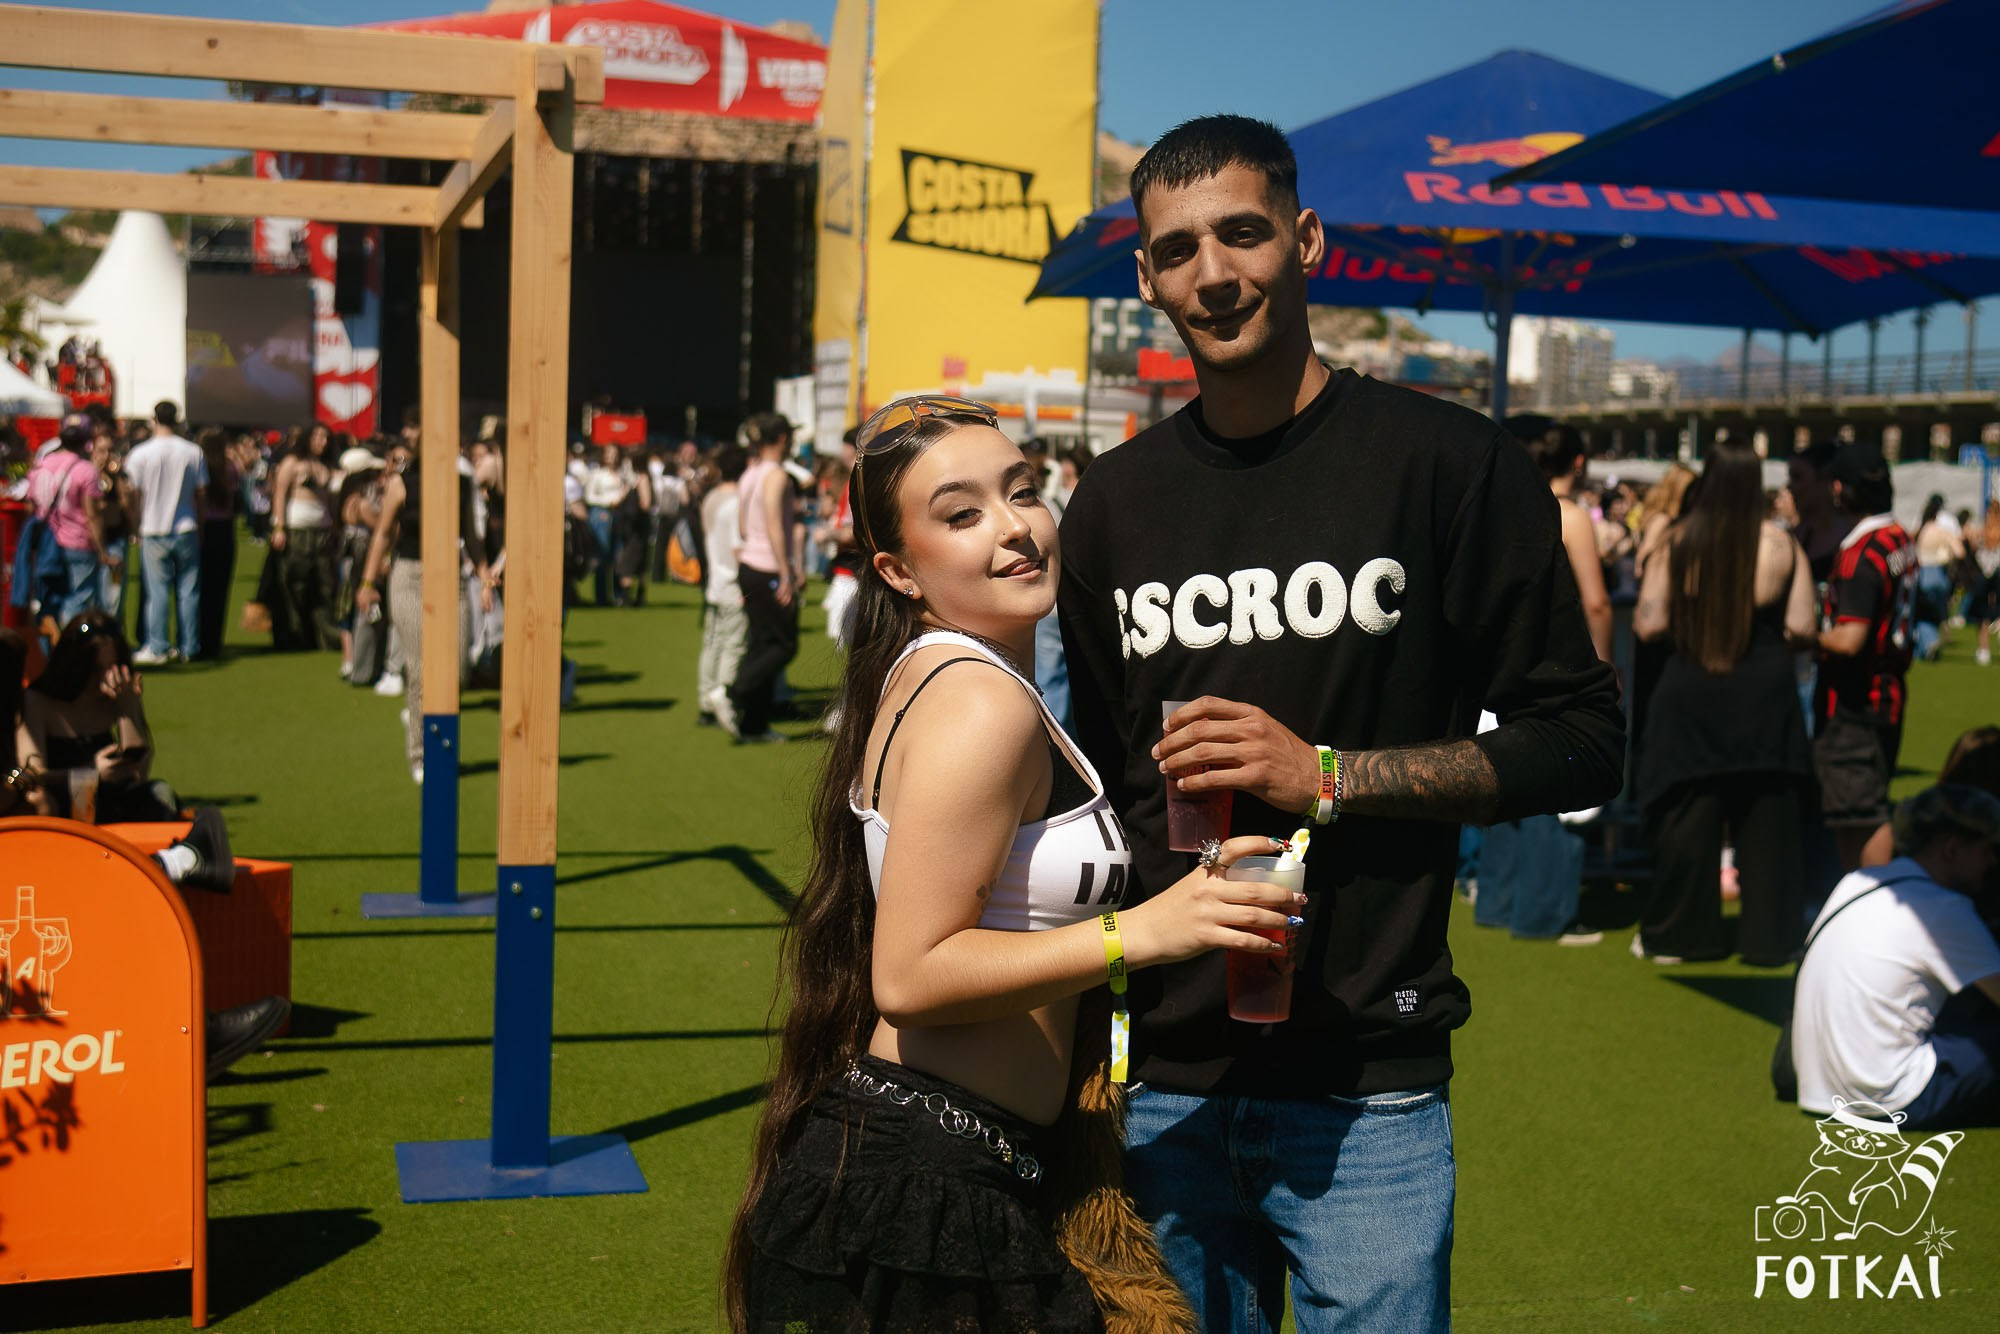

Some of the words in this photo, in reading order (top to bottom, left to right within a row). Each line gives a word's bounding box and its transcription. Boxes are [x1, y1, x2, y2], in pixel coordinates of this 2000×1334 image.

[602, 46, 705, 67] ONORA
[909, 155, 1023, 212] COSTA
[1403, 171, 1592, 209] Red
[1601, 183, 1779, 221] Bull
[907, 204, 1050, 263] SONORA
[1321, 752, 1332, 793] EUSKADI
[15, 956, 36, 980] A
[0, 1030, 125, 1089] EROL
